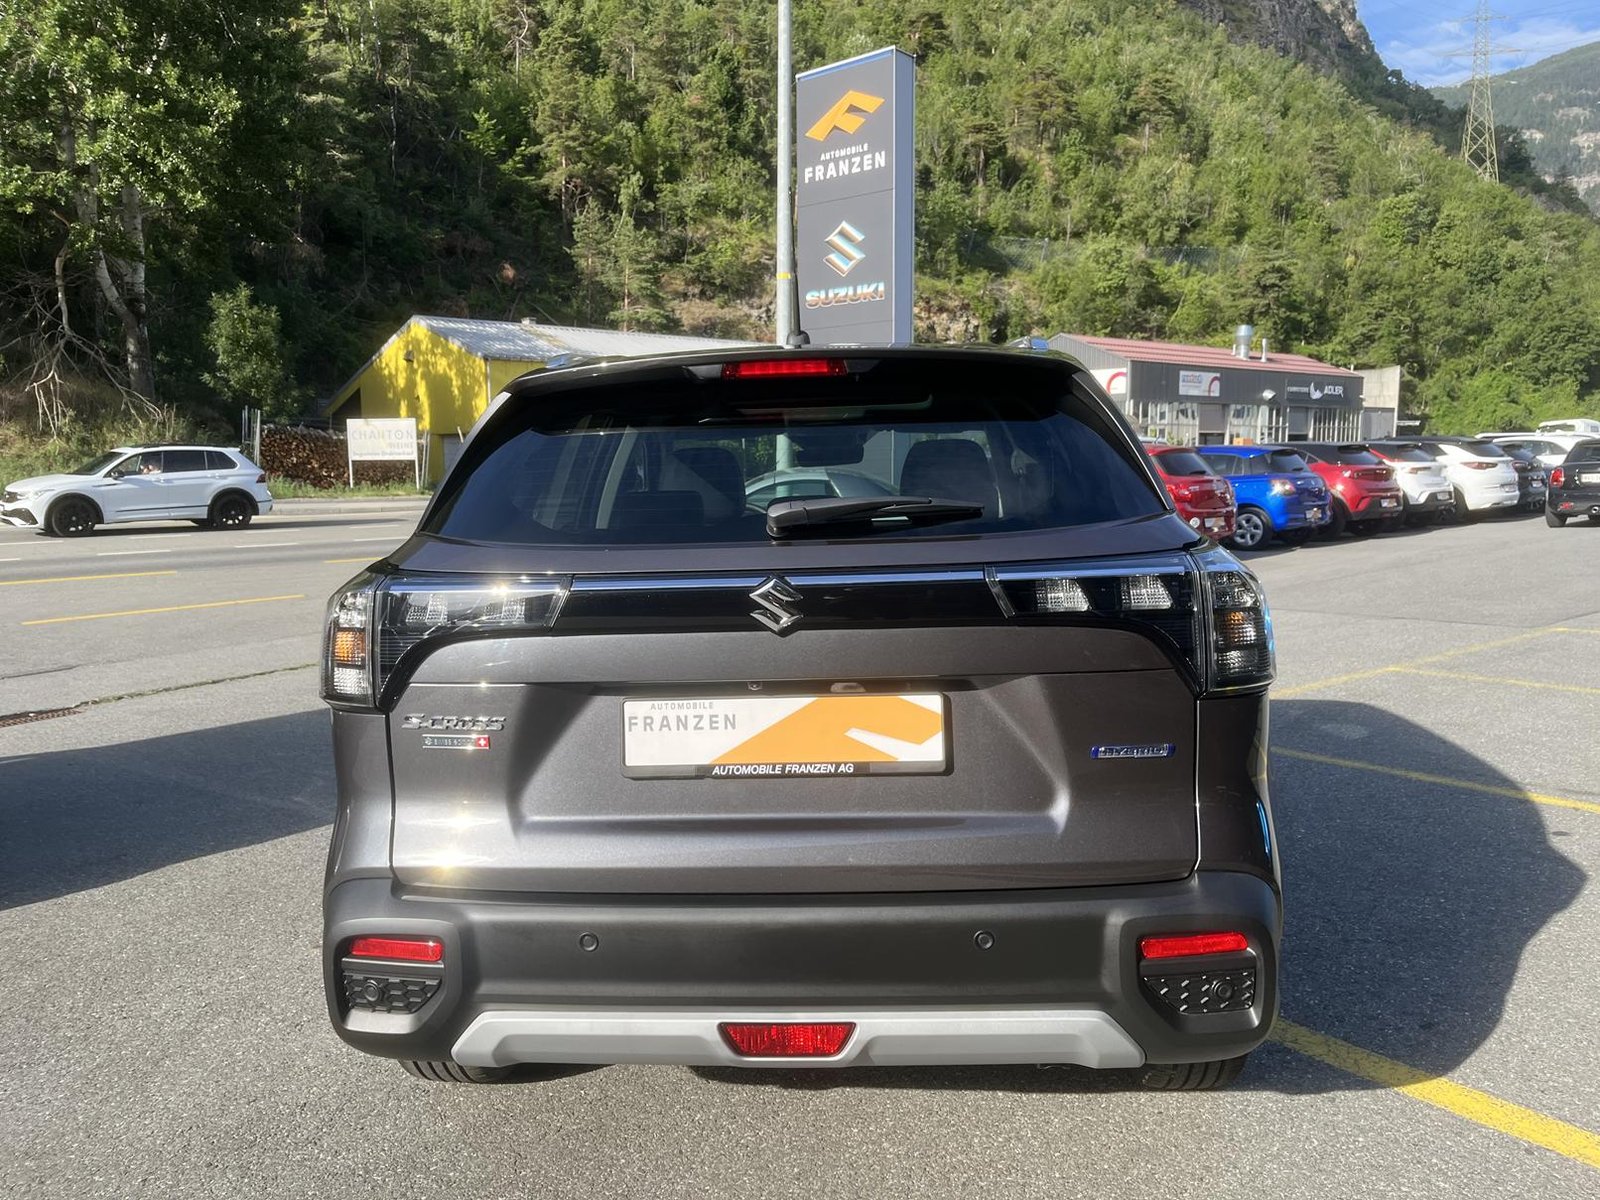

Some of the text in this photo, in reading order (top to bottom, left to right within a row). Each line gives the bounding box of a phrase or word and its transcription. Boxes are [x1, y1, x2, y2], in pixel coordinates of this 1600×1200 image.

[820, 143, 869, 161] AUTOMOBILE
[804, 150, 886, 184] FRANZEN
[804, 281, 885, 310] SUZUKI
[650, 701, 715, 710] AUTOMOBILE
[627, 714, 737, 732] FRANZEN
[712, 763, 854, 776] AUTOMOBILE FRANZEN AG
